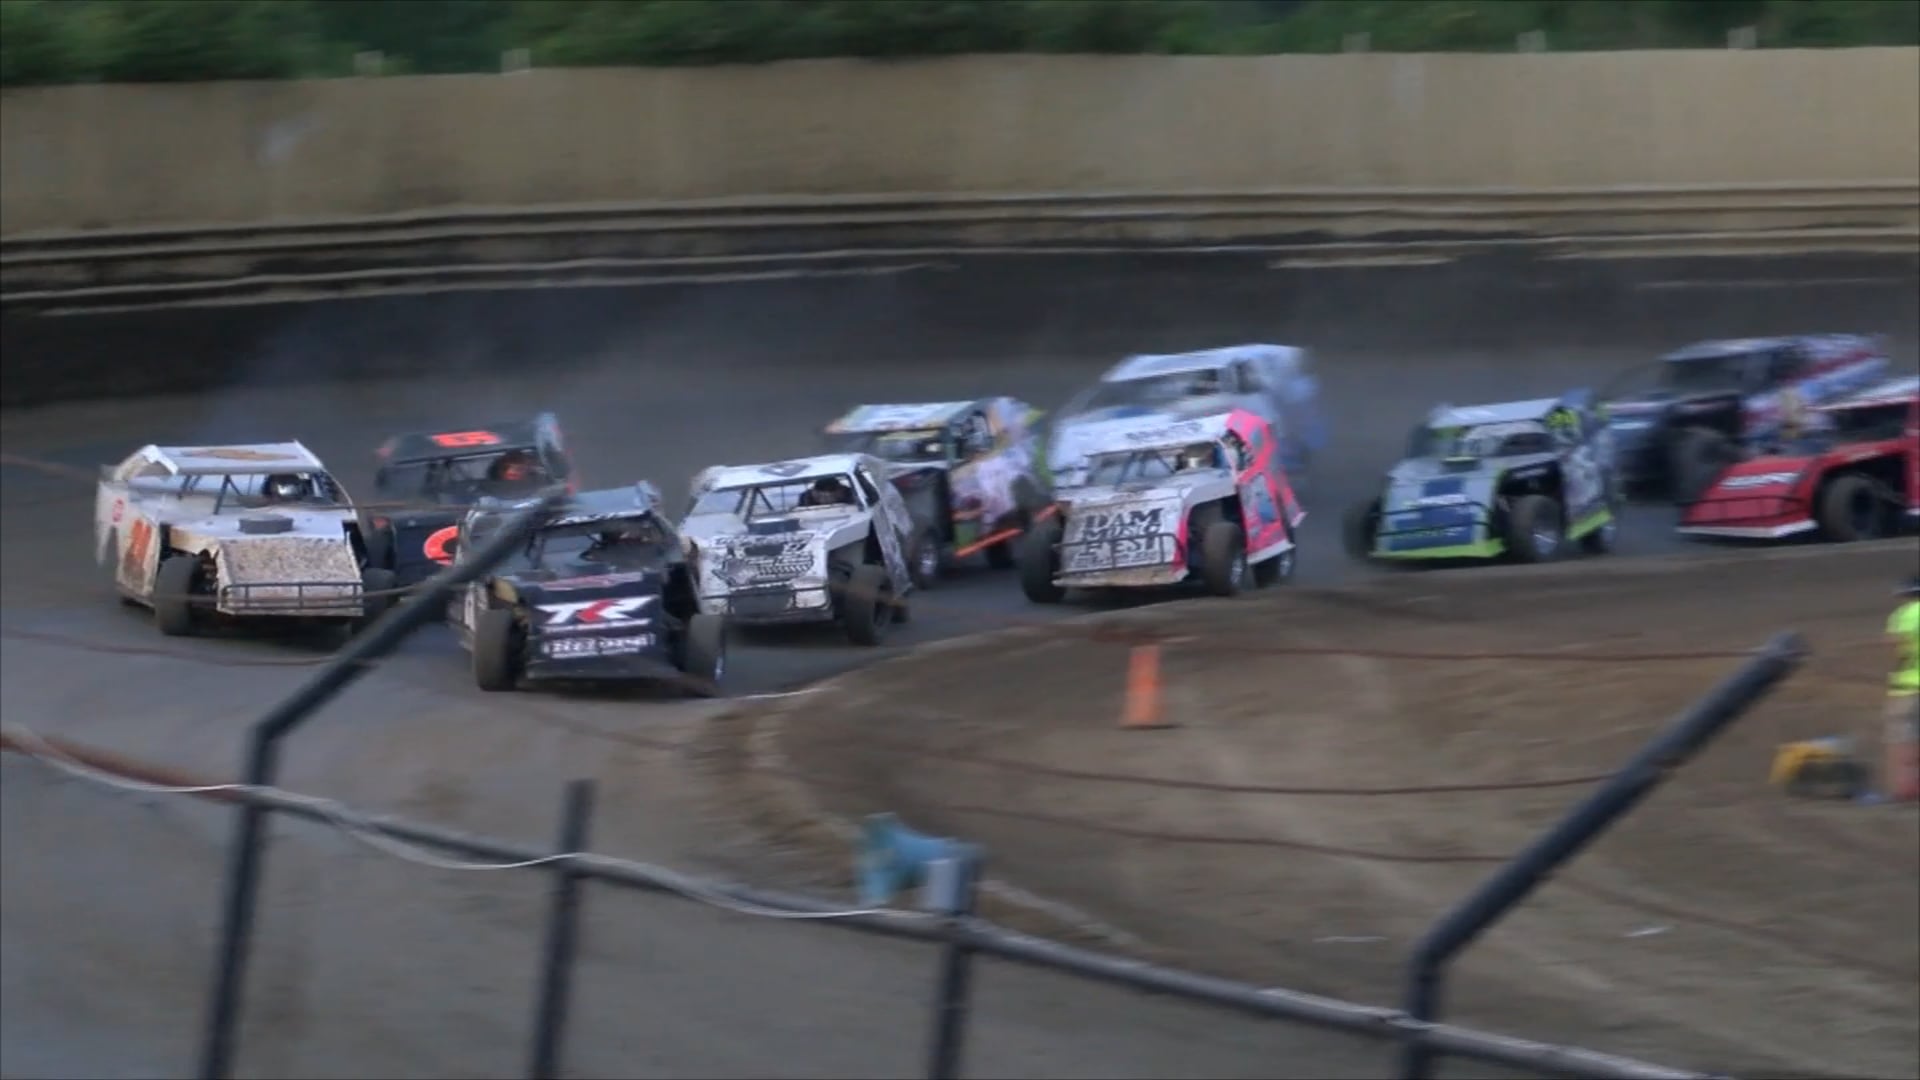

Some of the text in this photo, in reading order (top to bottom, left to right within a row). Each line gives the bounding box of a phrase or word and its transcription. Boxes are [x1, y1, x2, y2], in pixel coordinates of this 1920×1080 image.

[1084, 508, 1164, 528] DAM
[1081, 524, 1160, 541] MUSIC
[1079, 536, 1156, 556] FEST
